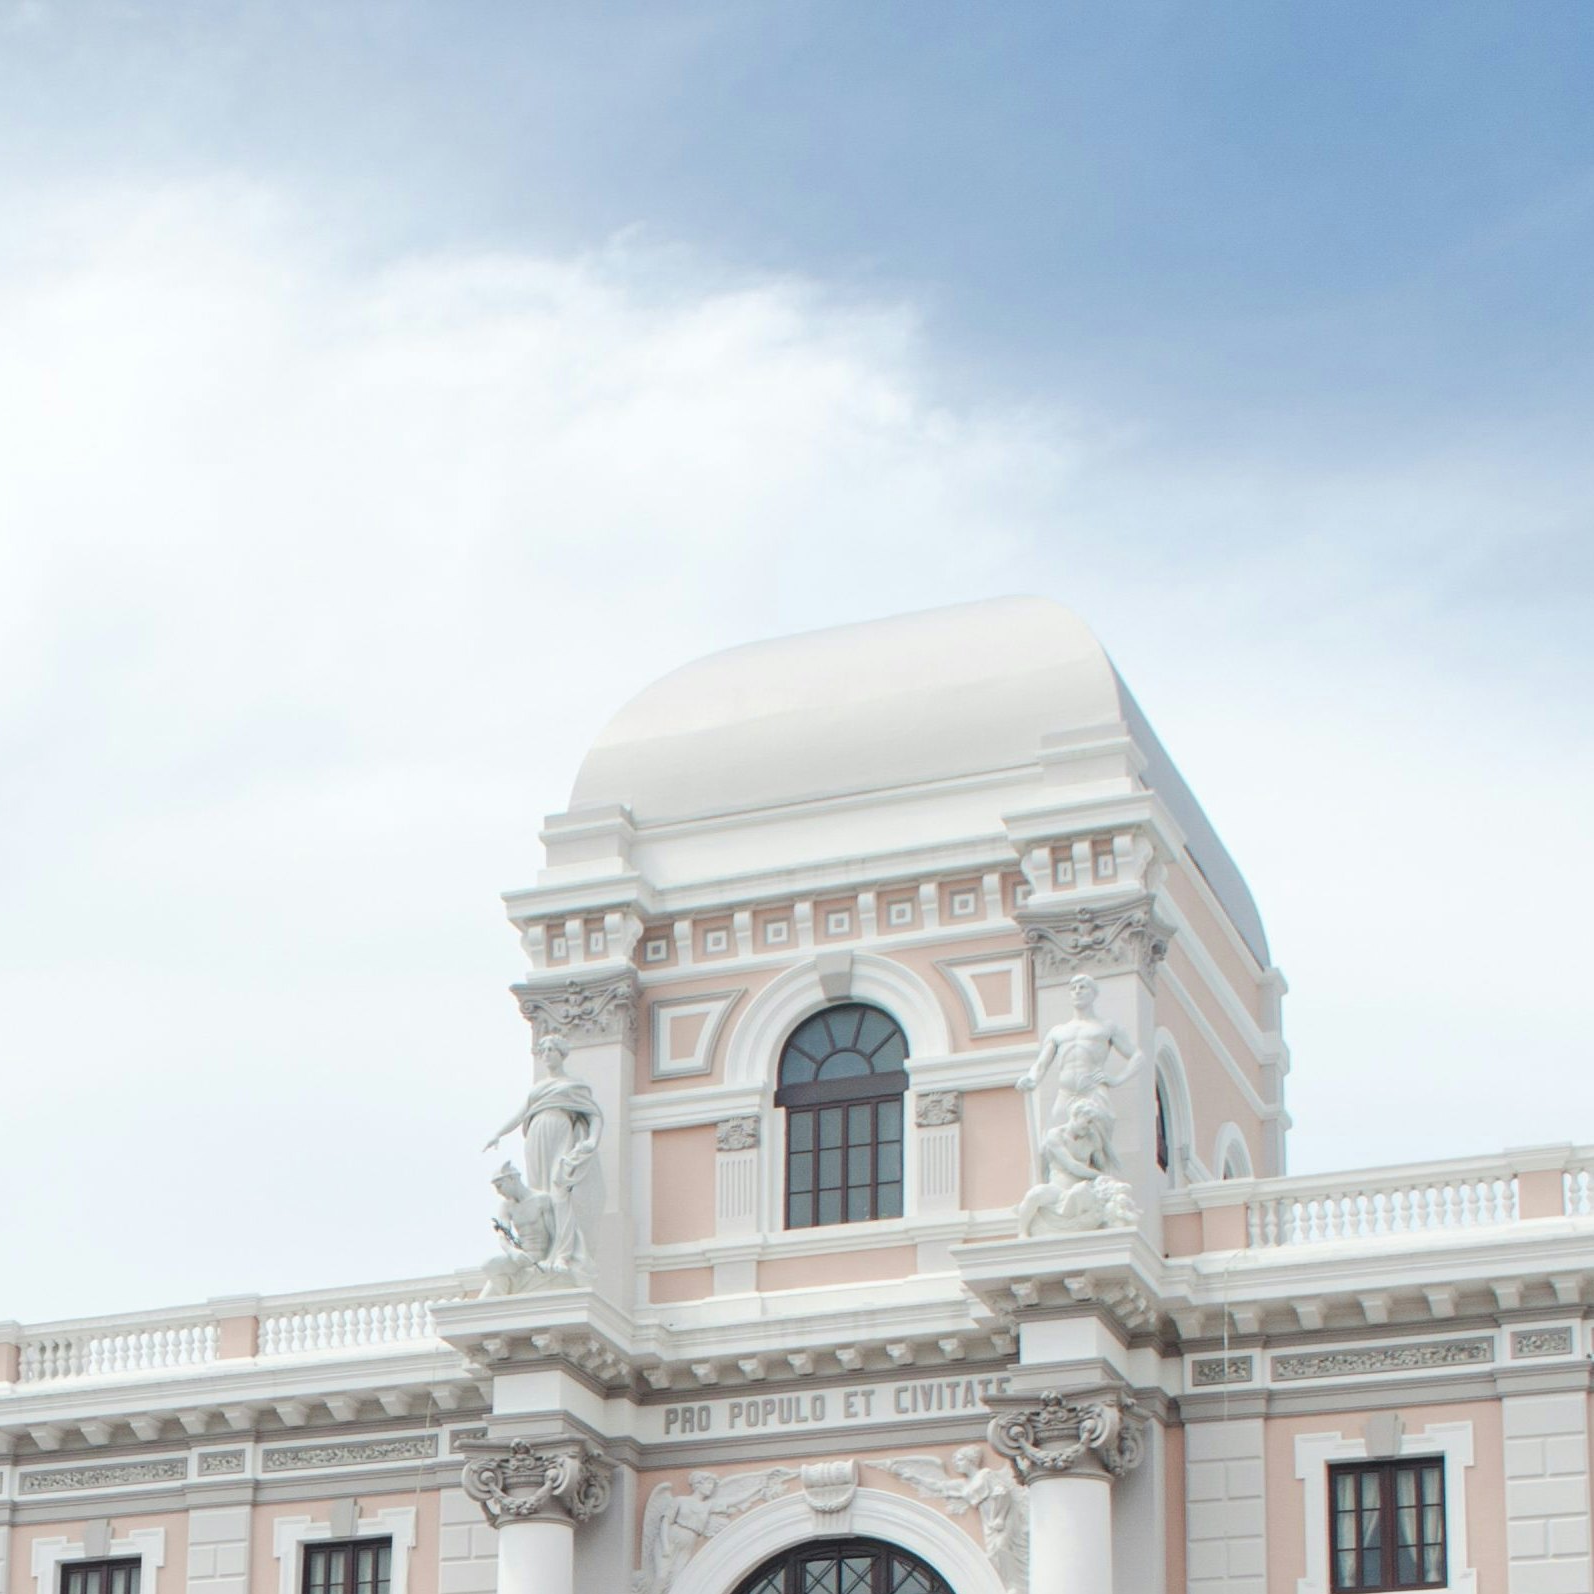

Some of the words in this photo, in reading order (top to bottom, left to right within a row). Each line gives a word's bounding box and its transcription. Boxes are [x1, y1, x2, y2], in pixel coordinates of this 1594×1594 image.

[664, 1404, 711, 1435] PRO
[728, 1394, 826, 1429] POPULO
[843, 1389, 876, 1419] ET
